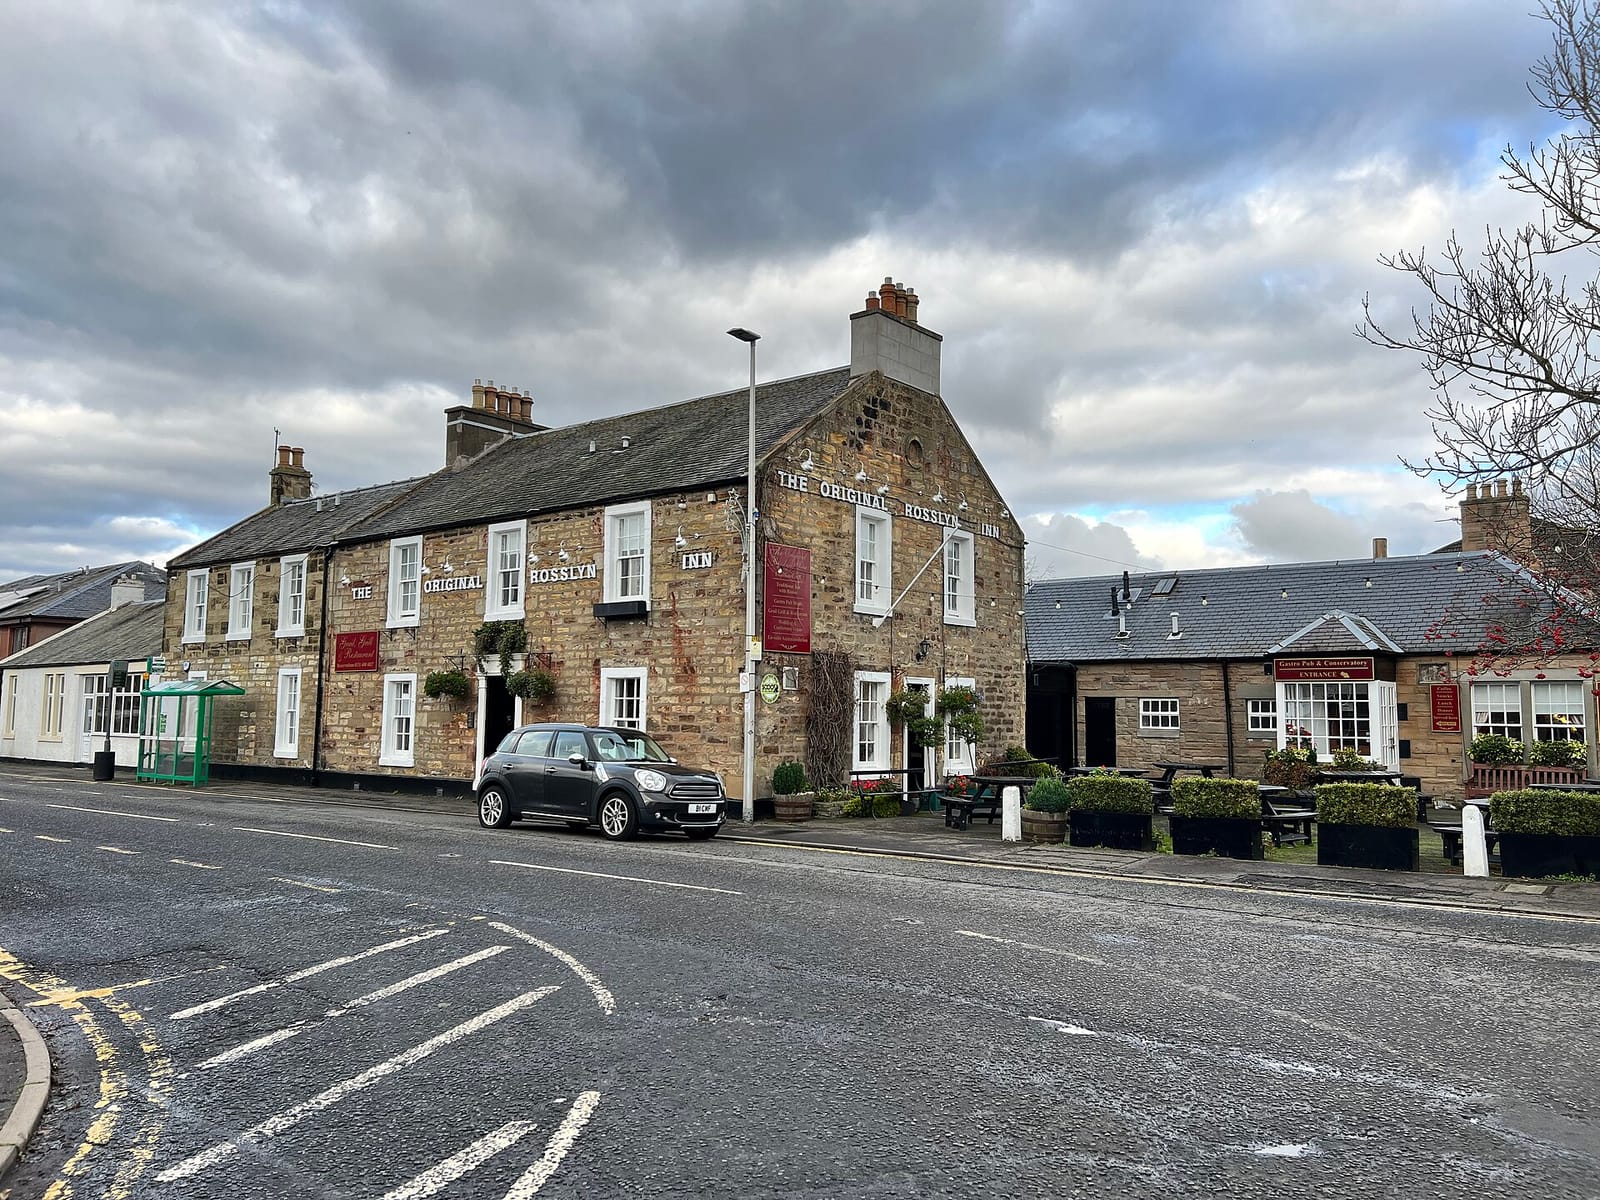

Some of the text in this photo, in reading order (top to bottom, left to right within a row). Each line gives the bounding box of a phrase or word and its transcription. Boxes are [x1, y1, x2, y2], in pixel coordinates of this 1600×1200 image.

[778, 470, 1000, 538] THE ORIGINAL ROSSLYN INN
[352, 552, 712, 600] THE ORIGINAL ROSSLYN INN
